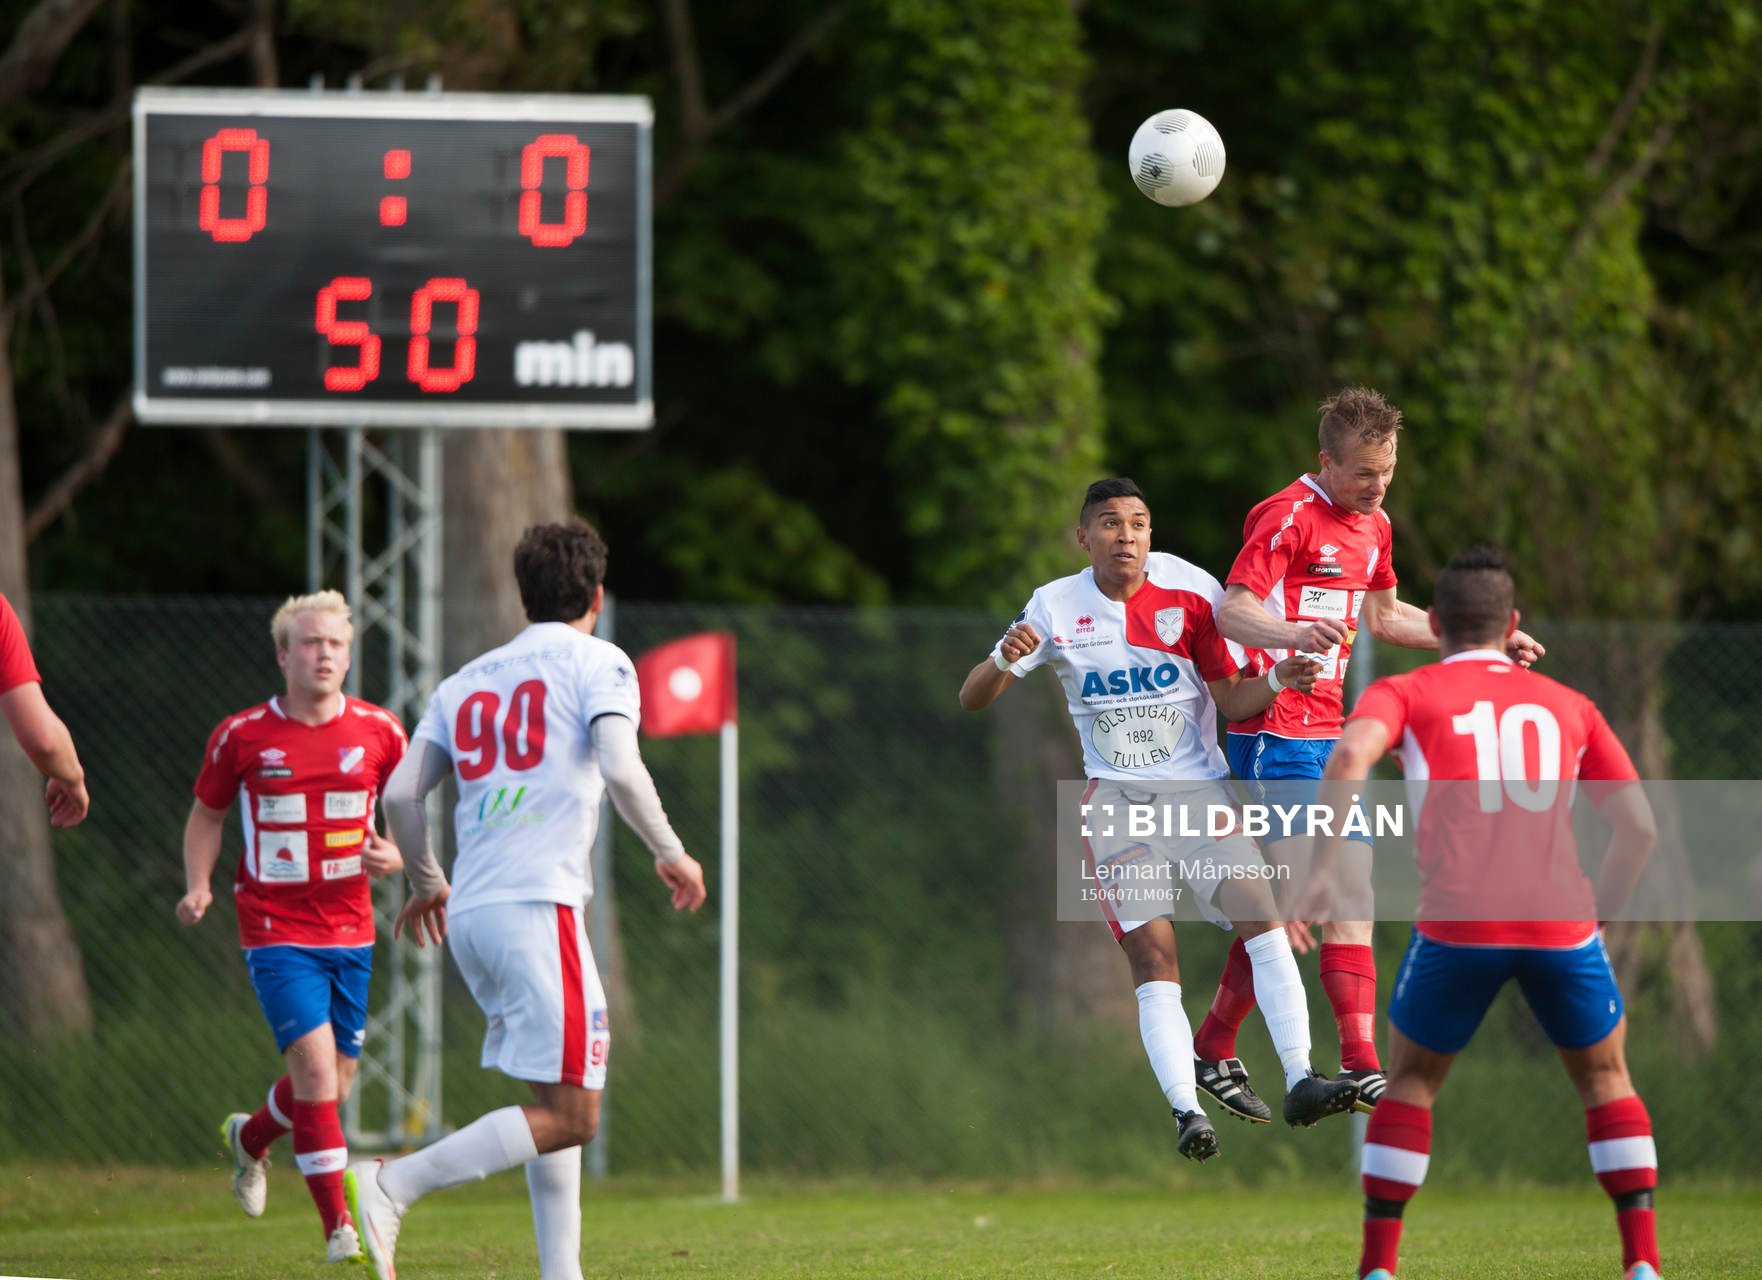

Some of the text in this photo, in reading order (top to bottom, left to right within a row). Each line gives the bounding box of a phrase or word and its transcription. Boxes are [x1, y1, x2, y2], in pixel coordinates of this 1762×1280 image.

[200, 128, 270, 243] 0
[518, 134, 591, 248] 0
[315, 276, 480, 392] 50
[513, 330, 635, 388] min
[1081, 662, 1180, 698] ASKO
[455, 679, 547, 781] 90
[1097, 704, 1180, 734] ÖLSTUGAN
[1126, 730, 1154, 744] 1892
[1112, 746, 1171, 768] TULLEN
[1452, 701, 1561, 813] 10
